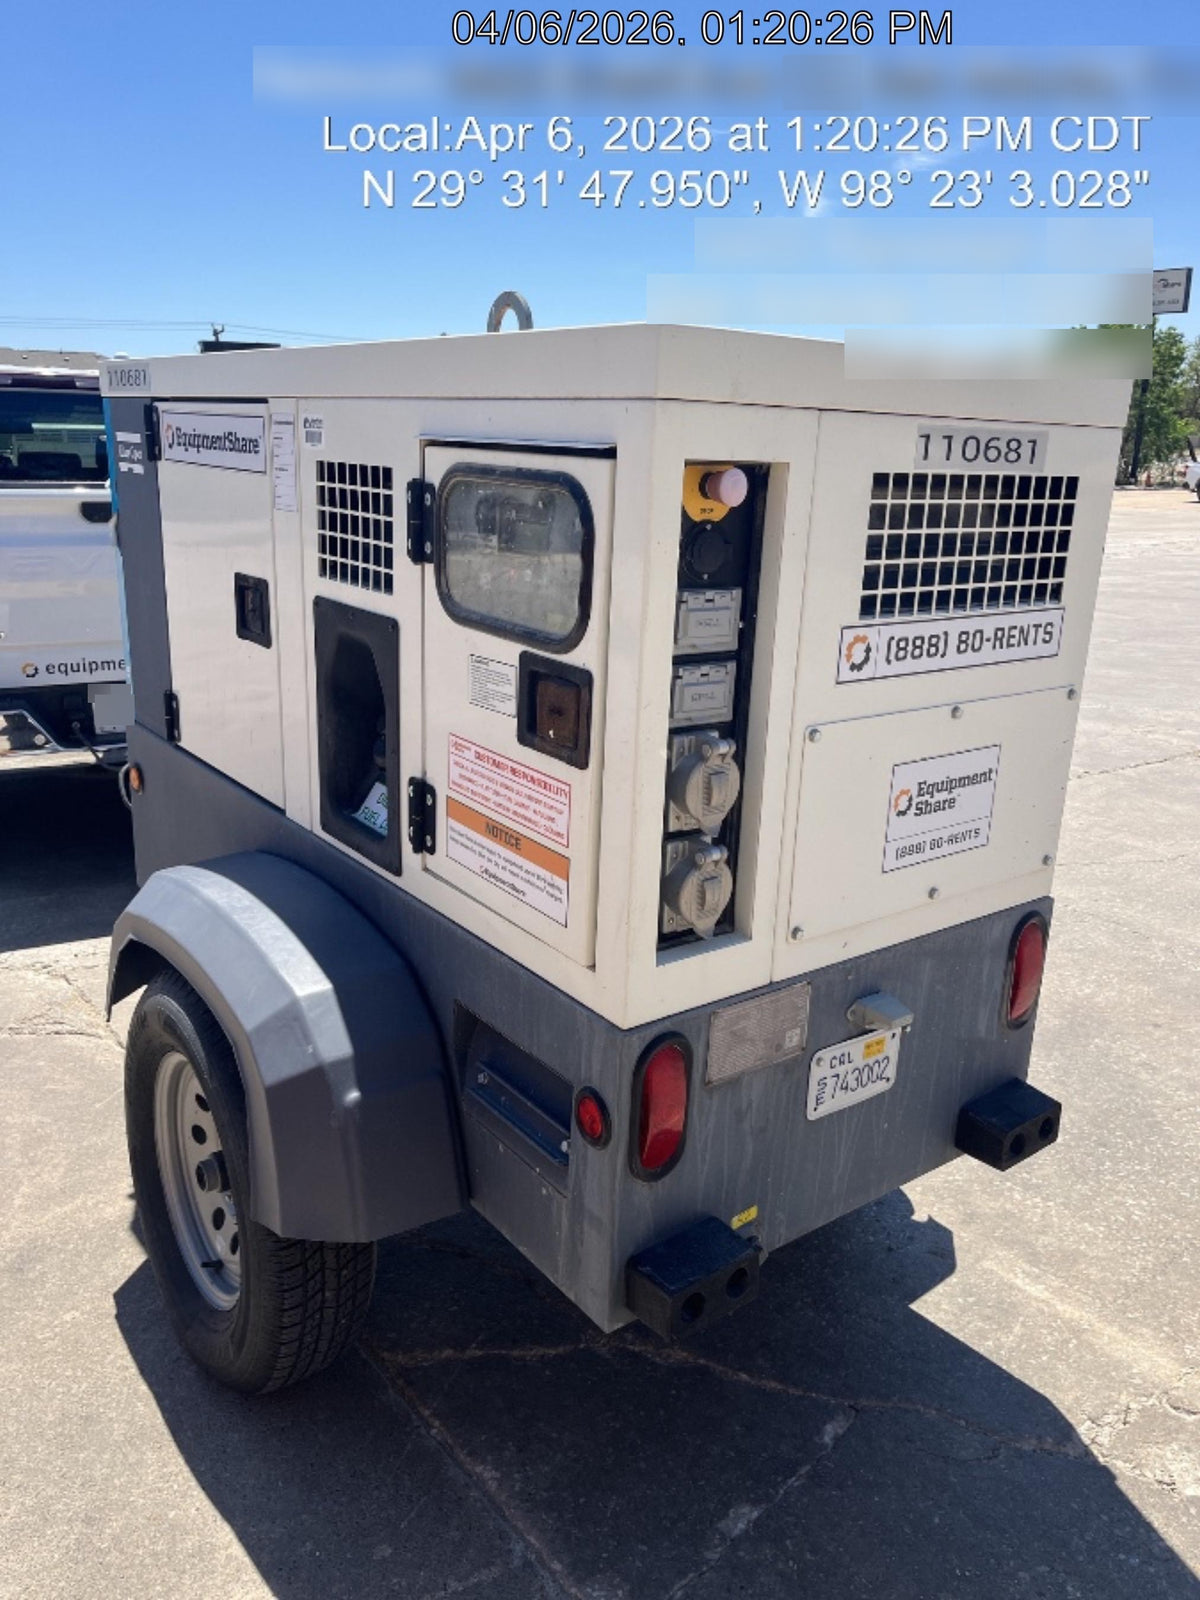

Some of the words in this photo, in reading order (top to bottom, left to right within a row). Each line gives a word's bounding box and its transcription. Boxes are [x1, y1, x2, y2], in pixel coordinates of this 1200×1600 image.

[107, 368, 147, 388] 110681
[175, 425, 260, 455] EquipmentShare
[917, 432, 1038, 465] 110681
[885, 630, 949, 665] (888)
[956, 621, 1054, 655] 80-RENTS
[45, 657, 126, 677] equipme
[916, 767, 993, 798] Equipment
[914, 796, 956, 817] Share
[485, 821, 522, 851] NOTICE
[829, 1051, 854, 1070] CAL
[831, 1055, 890, 1099] 743002
